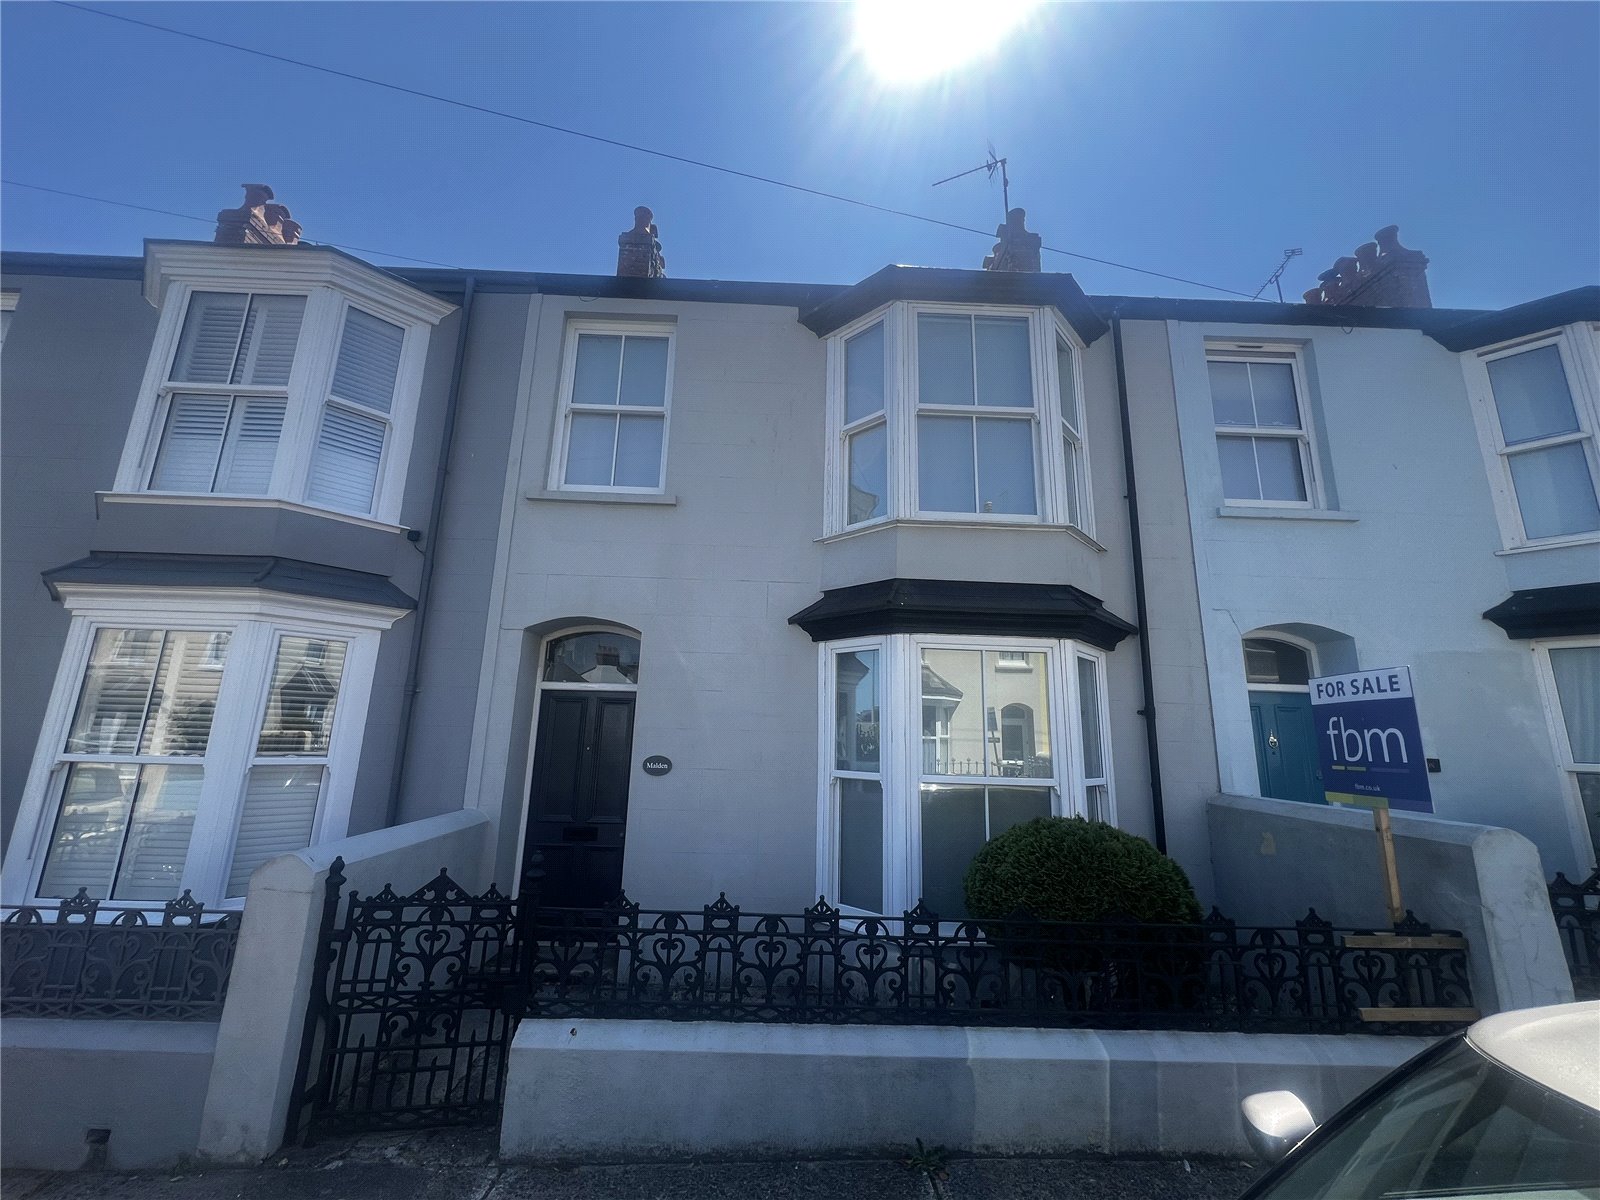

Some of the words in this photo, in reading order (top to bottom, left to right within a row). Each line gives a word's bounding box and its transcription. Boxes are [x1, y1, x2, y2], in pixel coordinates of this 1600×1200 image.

[1316, 680, 1346, 699] FOR
[1350, 674, 1401, 696] SALE
[1326, 716, 1408, 763] fbm
[1354, 783, 1381, 792] fbm.co.uk
